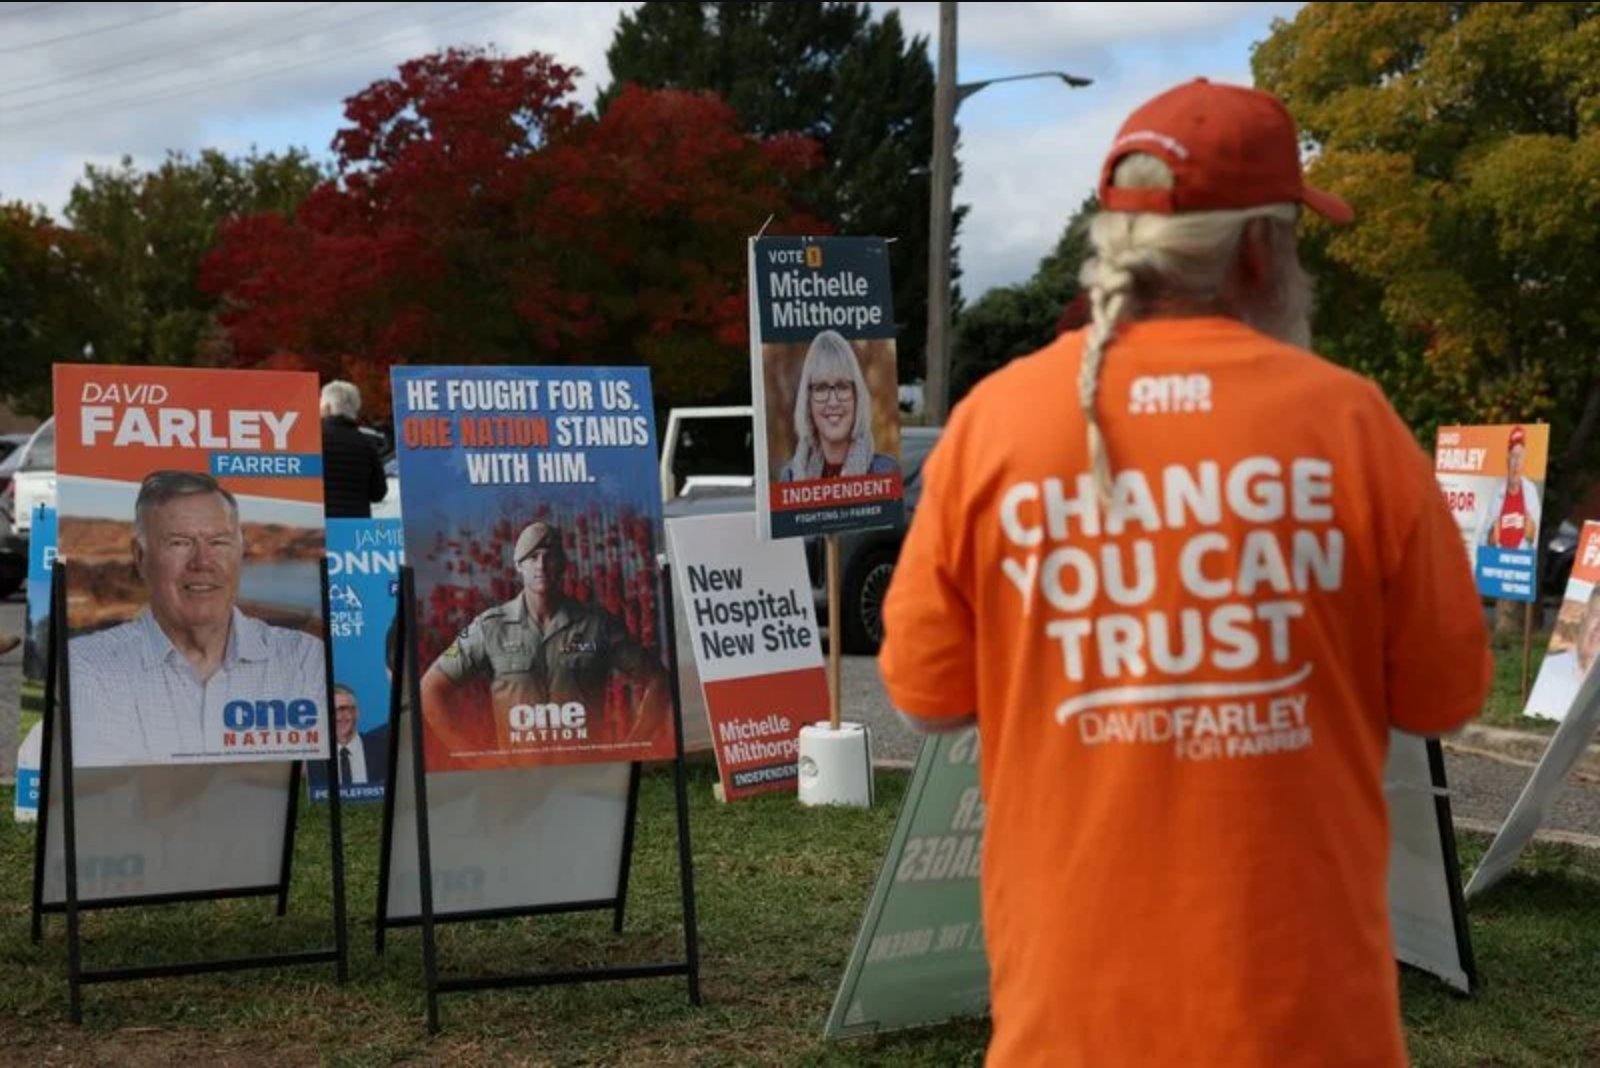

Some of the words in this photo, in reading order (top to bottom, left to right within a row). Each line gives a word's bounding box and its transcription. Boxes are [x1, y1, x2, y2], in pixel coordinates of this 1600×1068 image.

[768, 250, 804, 263] VOTE
[769, 269, 868, 298] Michelle
[771, 300, 882, 330] Milthorpe
[81, 382, 169, 405] DAVID
[407, 380, 439, 411] HE
[447, 380, 539, 411] FOUGHT
[547, 380, 592, 411] FOR
[600, 379, 639, 411] US.
[80, 405, 298, 450] FARLEY
[403, 417, 452, 448] ONE
[461, 417, 549, 448] NATION
[556, 416, 649, 447] STANDS
[217, 455, 301, 474] FARRER
[466, 453, 530, 484] WITH
[538, 453, 596, 483] HIM.
[782, 479, 893, 505] INDEPENDENT
[1000, 455, 1334, 547] CHANGE
[687, 564, 742, 593] New
[1001, 539, 1157, 616] YOU
[1178, 528, 1344, 599] CAN
[694, 589, 807, 628] Hospital,
[700, 629, 754, 660] New
[761, 620, 812, 652] Site
[1045, 602, 1305, 682] TRUST
[223, 698, 319, 731] one
[509, 701, 586, 730] one
[719, 714, 790, 743] Michelle
[223, 731, 319, 746] NATION
[511, 728, 588, 742] NATION
[723, 738, 800, 764] Milthorpe
